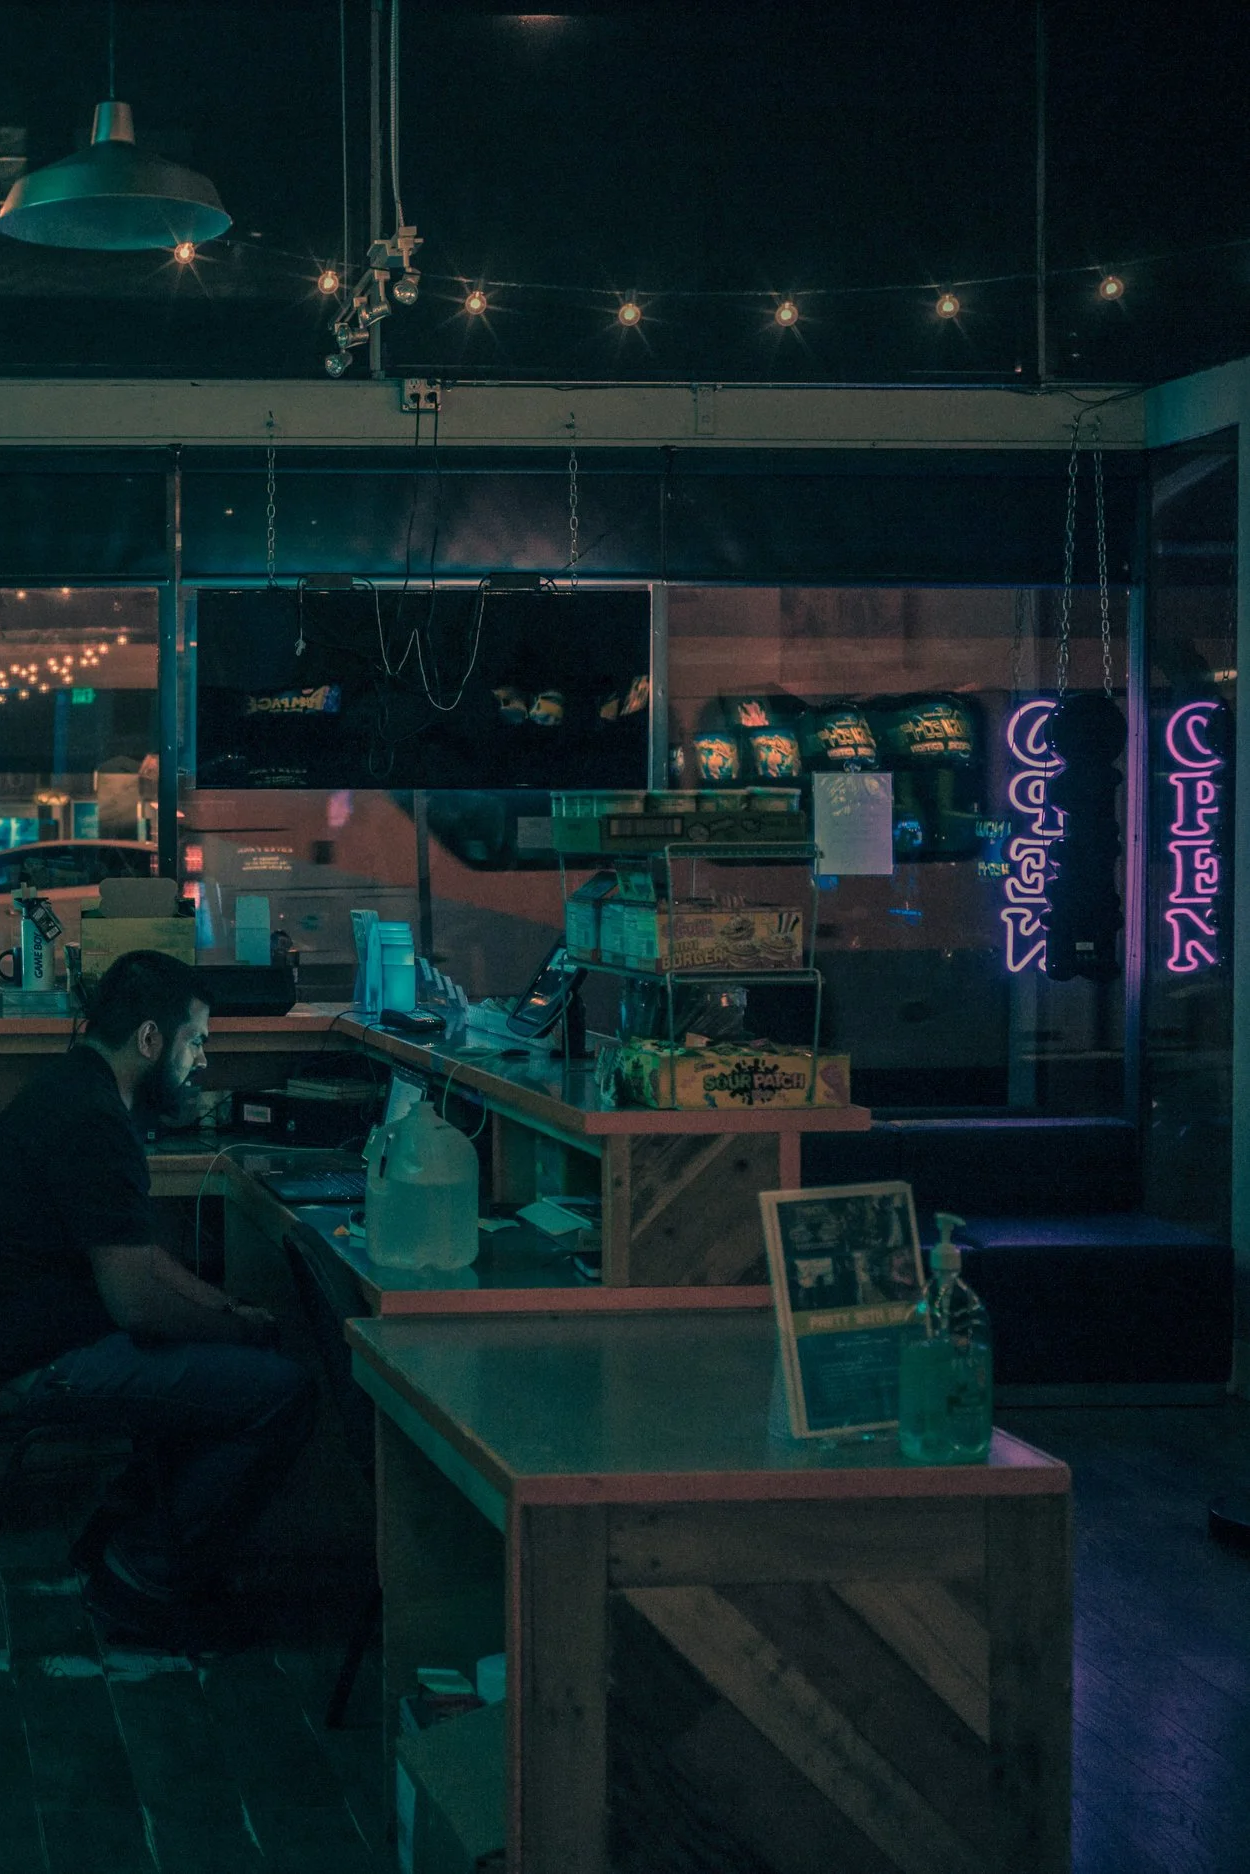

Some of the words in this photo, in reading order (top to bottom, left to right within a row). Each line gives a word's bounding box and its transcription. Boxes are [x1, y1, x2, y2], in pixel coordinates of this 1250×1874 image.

[34, 952, 43, 979] GAME
[661, 947, 727, 970] BURGER
[703, 1073, 751, 1091] SOUR
[752, 1072, 805, 1090] PATCH
